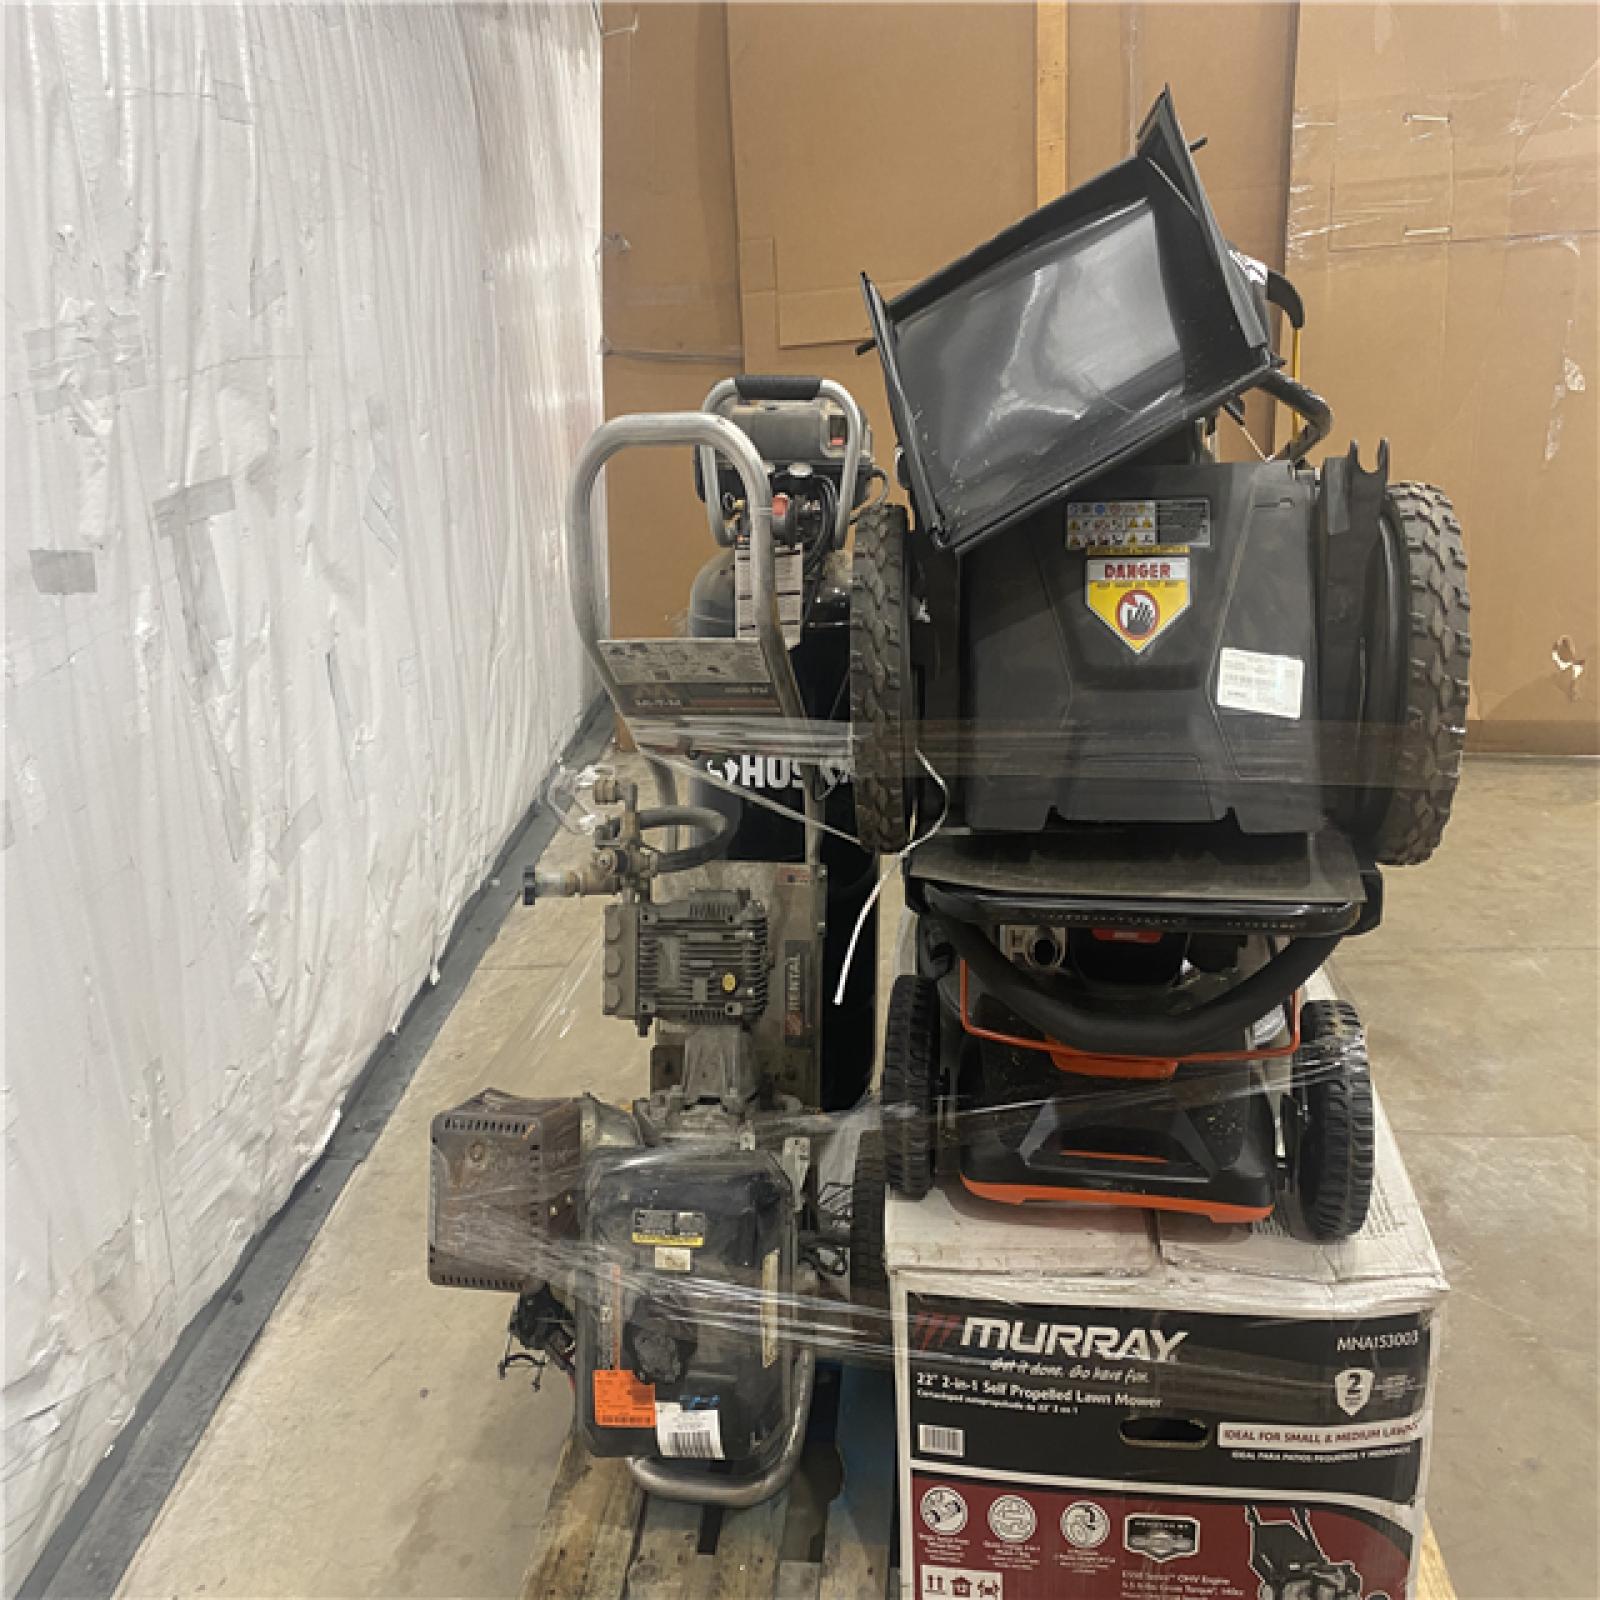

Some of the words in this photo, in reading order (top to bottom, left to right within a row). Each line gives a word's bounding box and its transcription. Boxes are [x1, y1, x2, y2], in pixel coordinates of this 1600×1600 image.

[1104, 563, 1171, 579] DANGER
[959, 1317, 1189, 1361] MURRAY
[982, 1379, 1008, 1396] Self
[1009, 1383, 1073, 1403] Propelled
[1075, 1389, 1112, 1405] Lawn
[1114, 1391, 1161, 1409] Mower
[1347, 1371, 1361, 1395] 2
[1224, 1429, 1256, 1441] IDEAL
[1259, 1431, 1281, 1442] FOR
[1284, 1431, 1321, 1443] SMALL
[1335, 1428, 1381, 1443] MEDIUM
